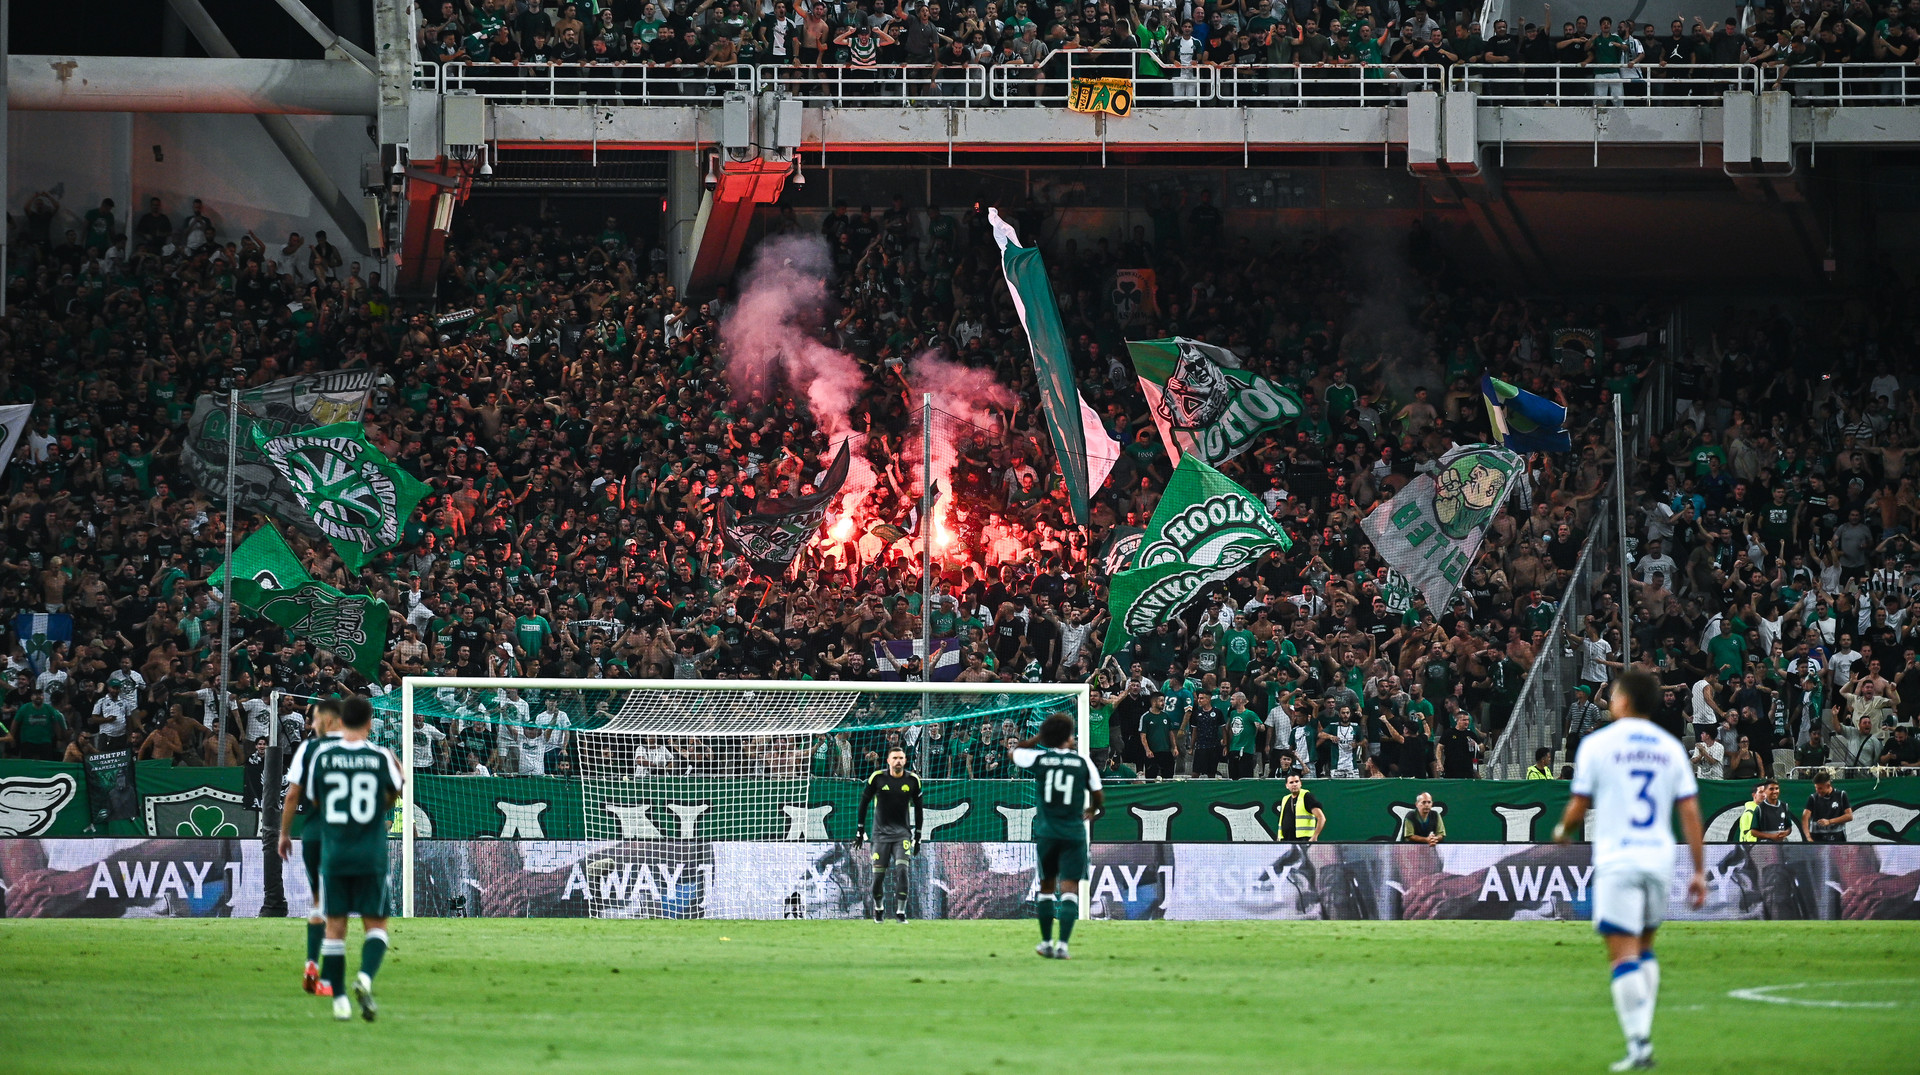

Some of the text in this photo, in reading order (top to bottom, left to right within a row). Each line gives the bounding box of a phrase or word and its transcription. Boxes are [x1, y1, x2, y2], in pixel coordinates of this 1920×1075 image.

[323, 771, 379, 824] 28
[1044, 768, 1075, 806] 14
[1629, 769, 1657, 828] 3
[86, 861, 213, 899] AWAY
[561, 863, 686, 901] AWAY
[1478, 865, 1596, 901] AWAY
